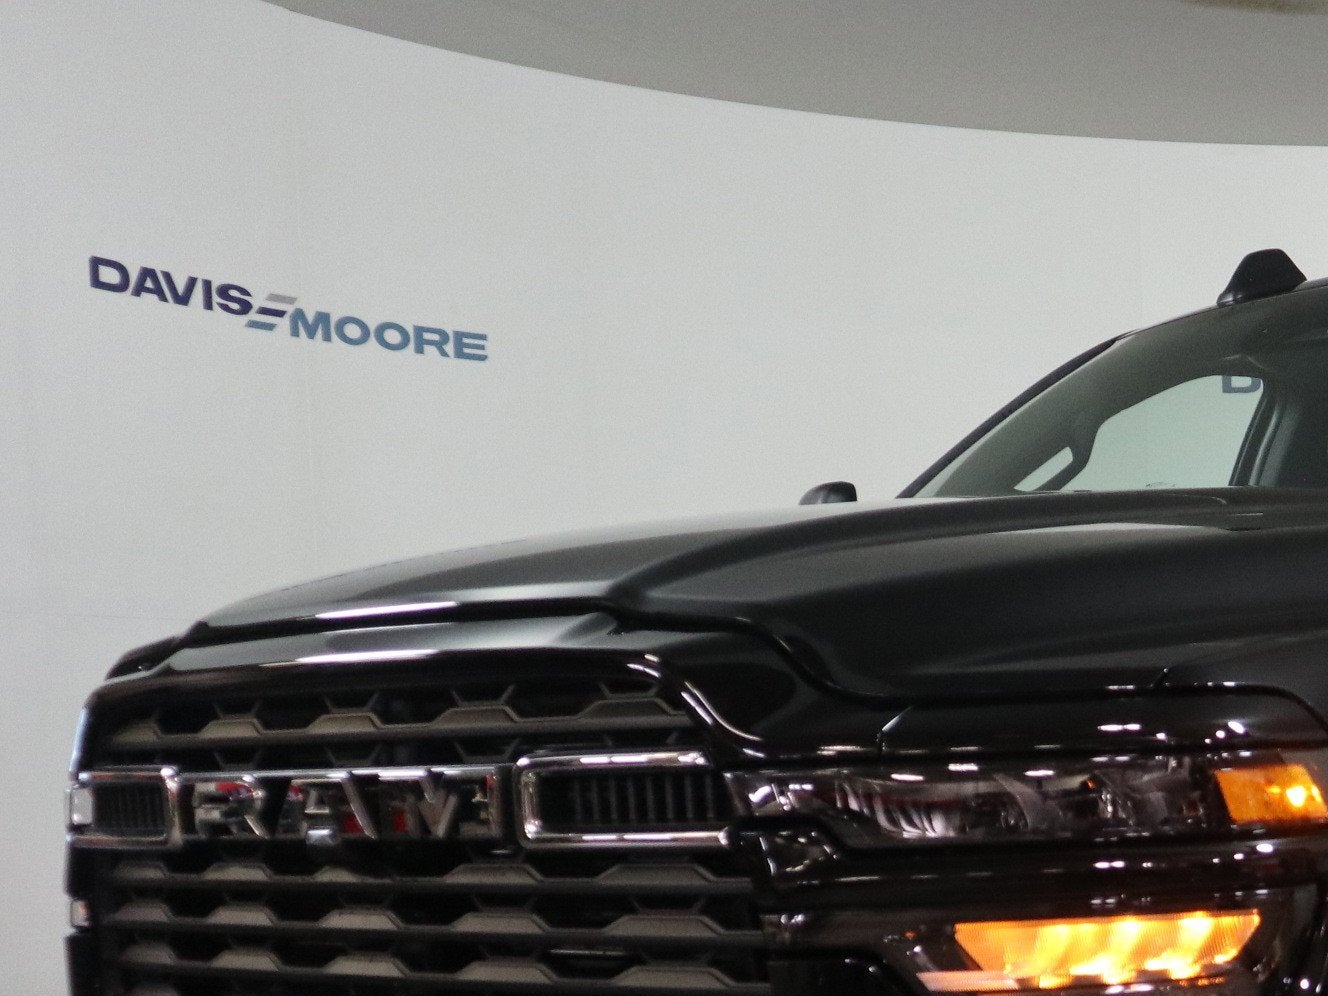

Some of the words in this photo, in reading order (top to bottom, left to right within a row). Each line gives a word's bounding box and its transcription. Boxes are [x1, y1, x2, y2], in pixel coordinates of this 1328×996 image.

[87, 255, 254, 316] DAVIS
[289, 307, 489, 361] MOORE
[192, 768, 498, 842] RAM
